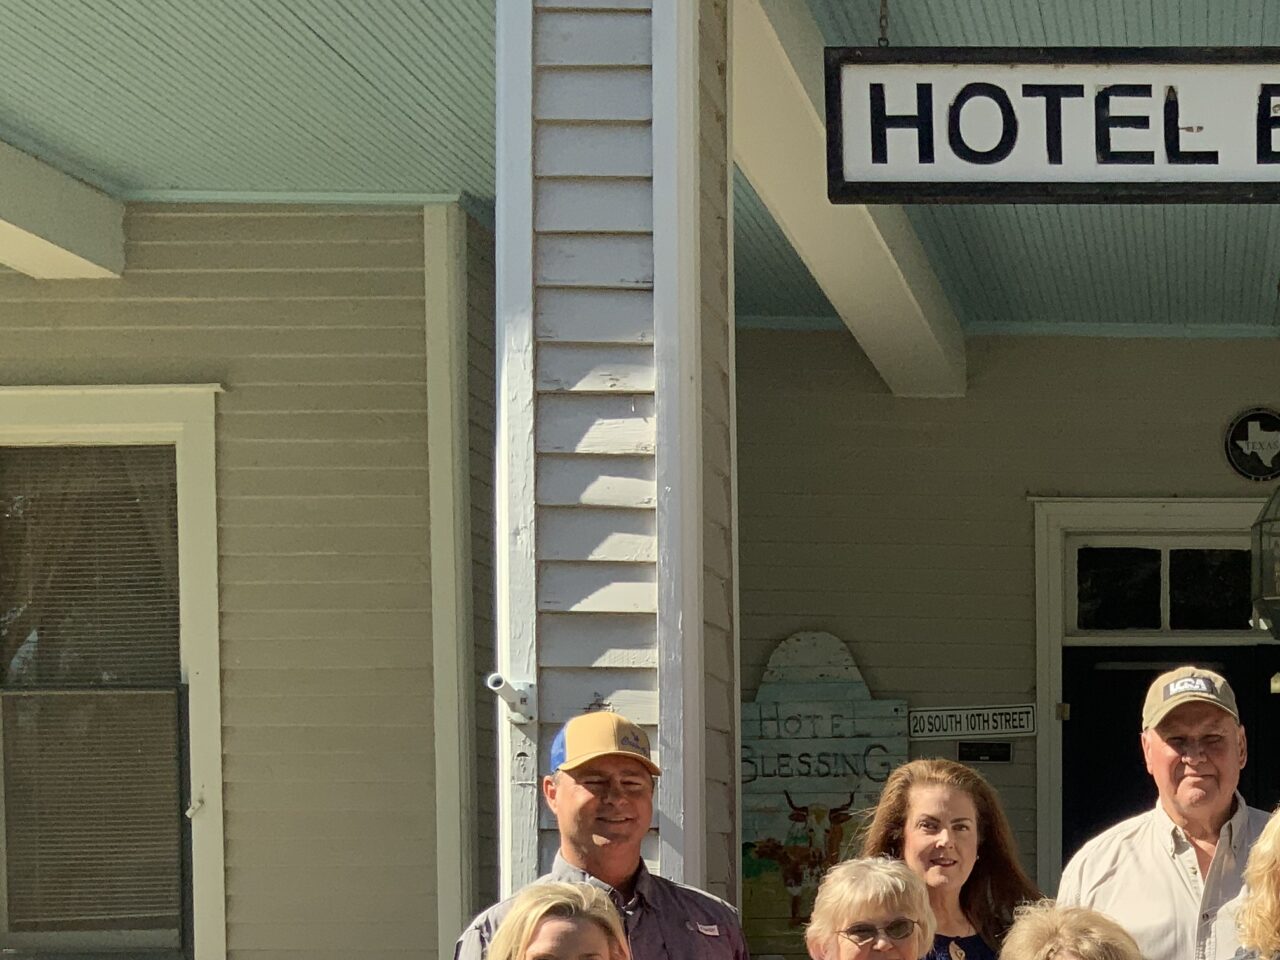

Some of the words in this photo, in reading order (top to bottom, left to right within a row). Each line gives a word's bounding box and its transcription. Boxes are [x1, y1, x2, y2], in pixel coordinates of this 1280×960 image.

[870, 82, 1220, 166] HOTEL
[1246, 440, 1280, 451] TEXAS
[1169, 677, 1208, 696] LCRA
[758, 701, 872, 739] HOTEL
[912, 715, 925, 733] 20
[927, 713, 962, 733] SOUTH
[965, 713, 990, 731] 10TH
[992, 710, 1031, 730] STREET
[741, 744, 891, 784] BLESSING
